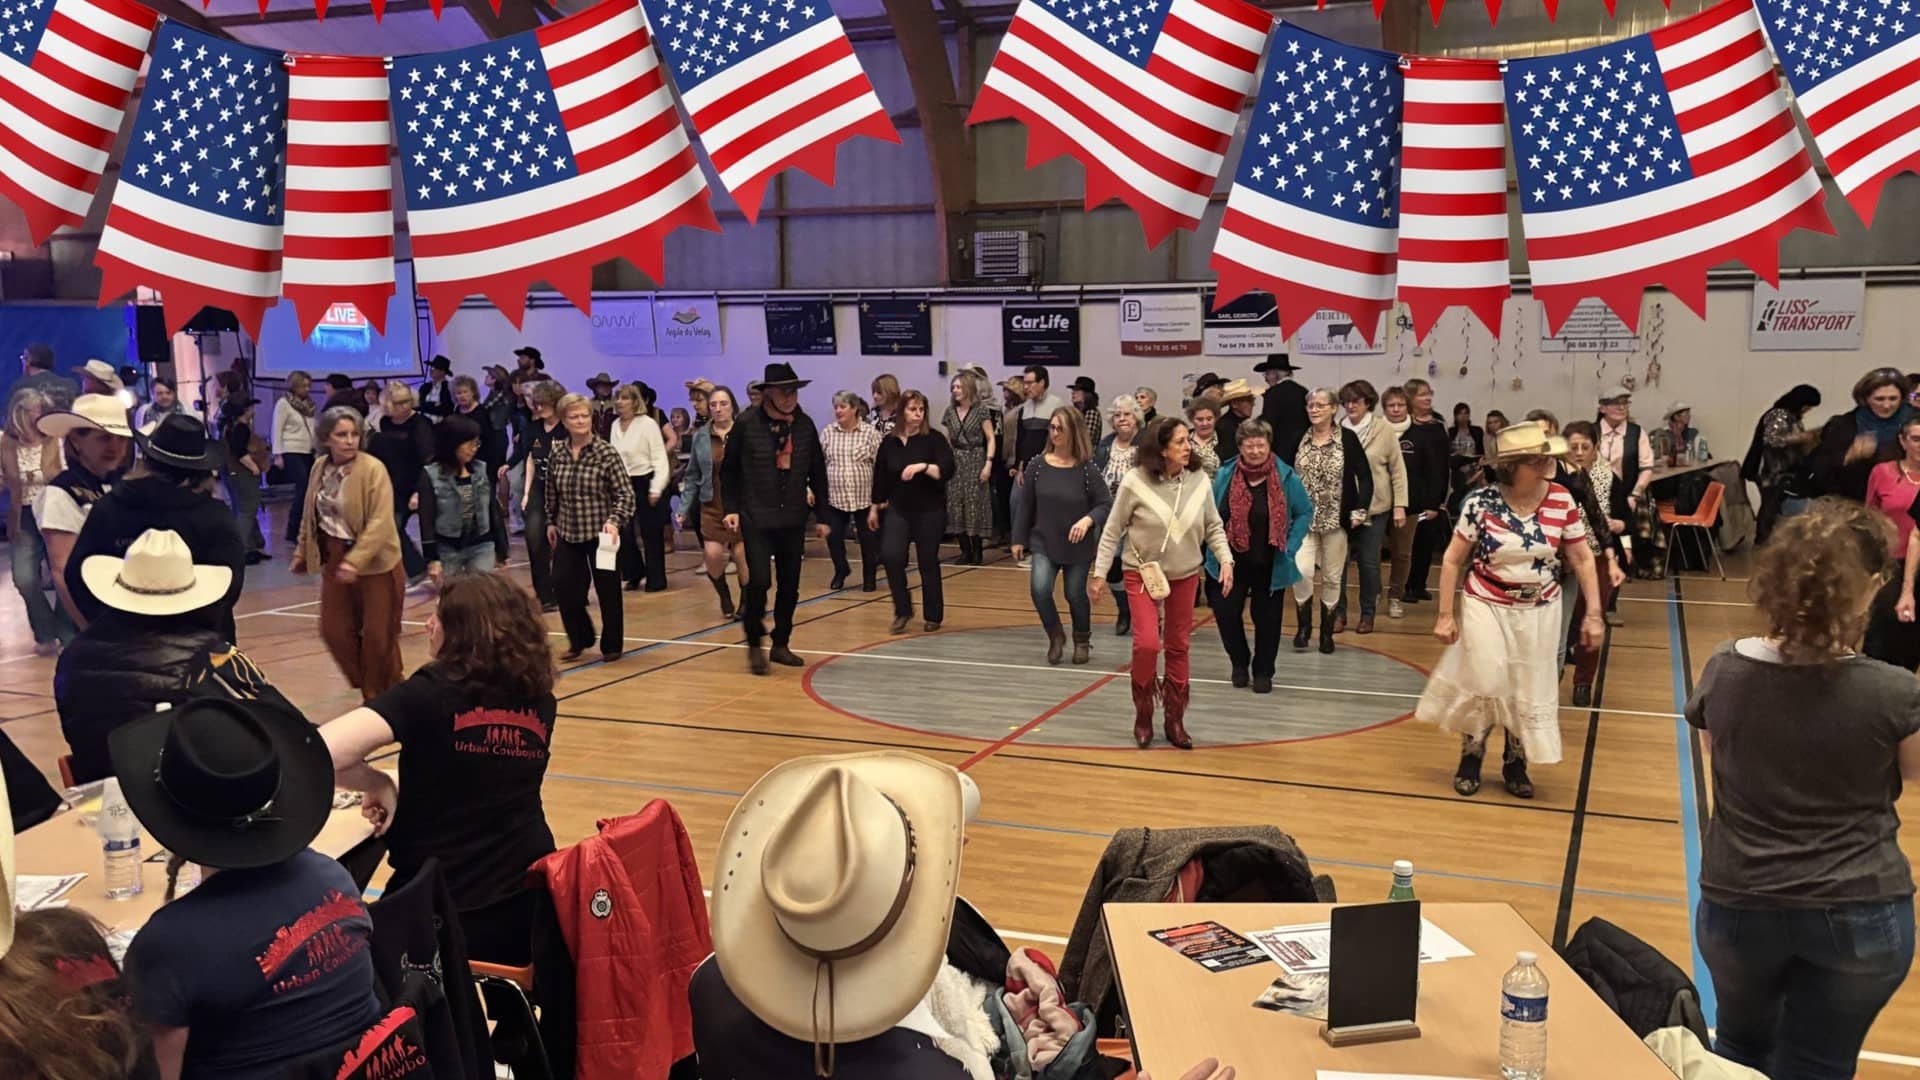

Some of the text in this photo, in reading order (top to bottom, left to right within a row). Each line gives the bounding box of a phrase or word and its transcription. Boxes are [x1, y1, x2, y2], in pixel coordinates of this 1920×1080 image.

[326, 306, 358, 323] LIVE
[1777, 299, 1810, 315] LISS
[1011, 314, 1070, 329] CarLife
[1772, 314, 1856, 332] TRANSPORT
[454, 740, 489, 753] Urban
[272, 967, 320, 993] Urban
